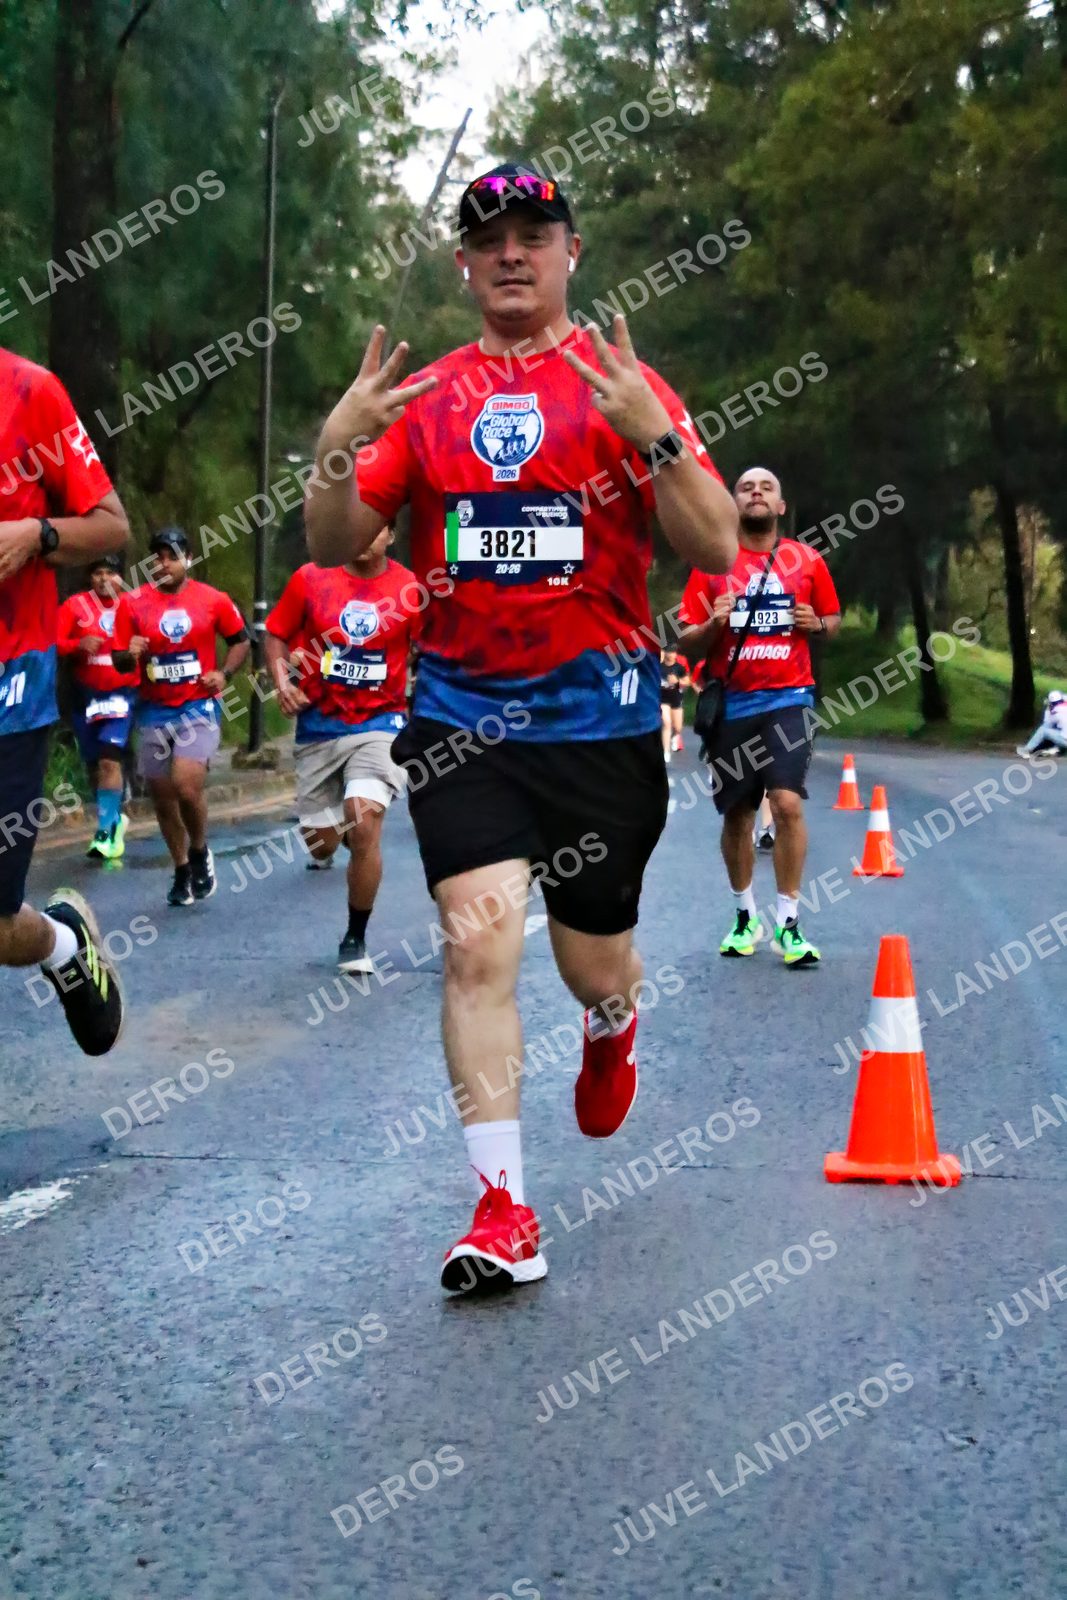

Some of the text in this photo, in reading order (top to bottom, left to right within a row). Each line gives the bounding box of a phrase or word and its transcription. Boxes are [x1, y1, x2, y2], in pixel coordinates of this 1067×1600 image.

[490, 415, 527, 427] Global
[482, 427, 513, 439] Race
[495, 469, 517, 480] 2026
[480, 529, 536, 558] 3821
[547, 576, 569, 586] 10K
[162, 665, 186, 678] 3859
[341, 662, 369, 679] 3872
